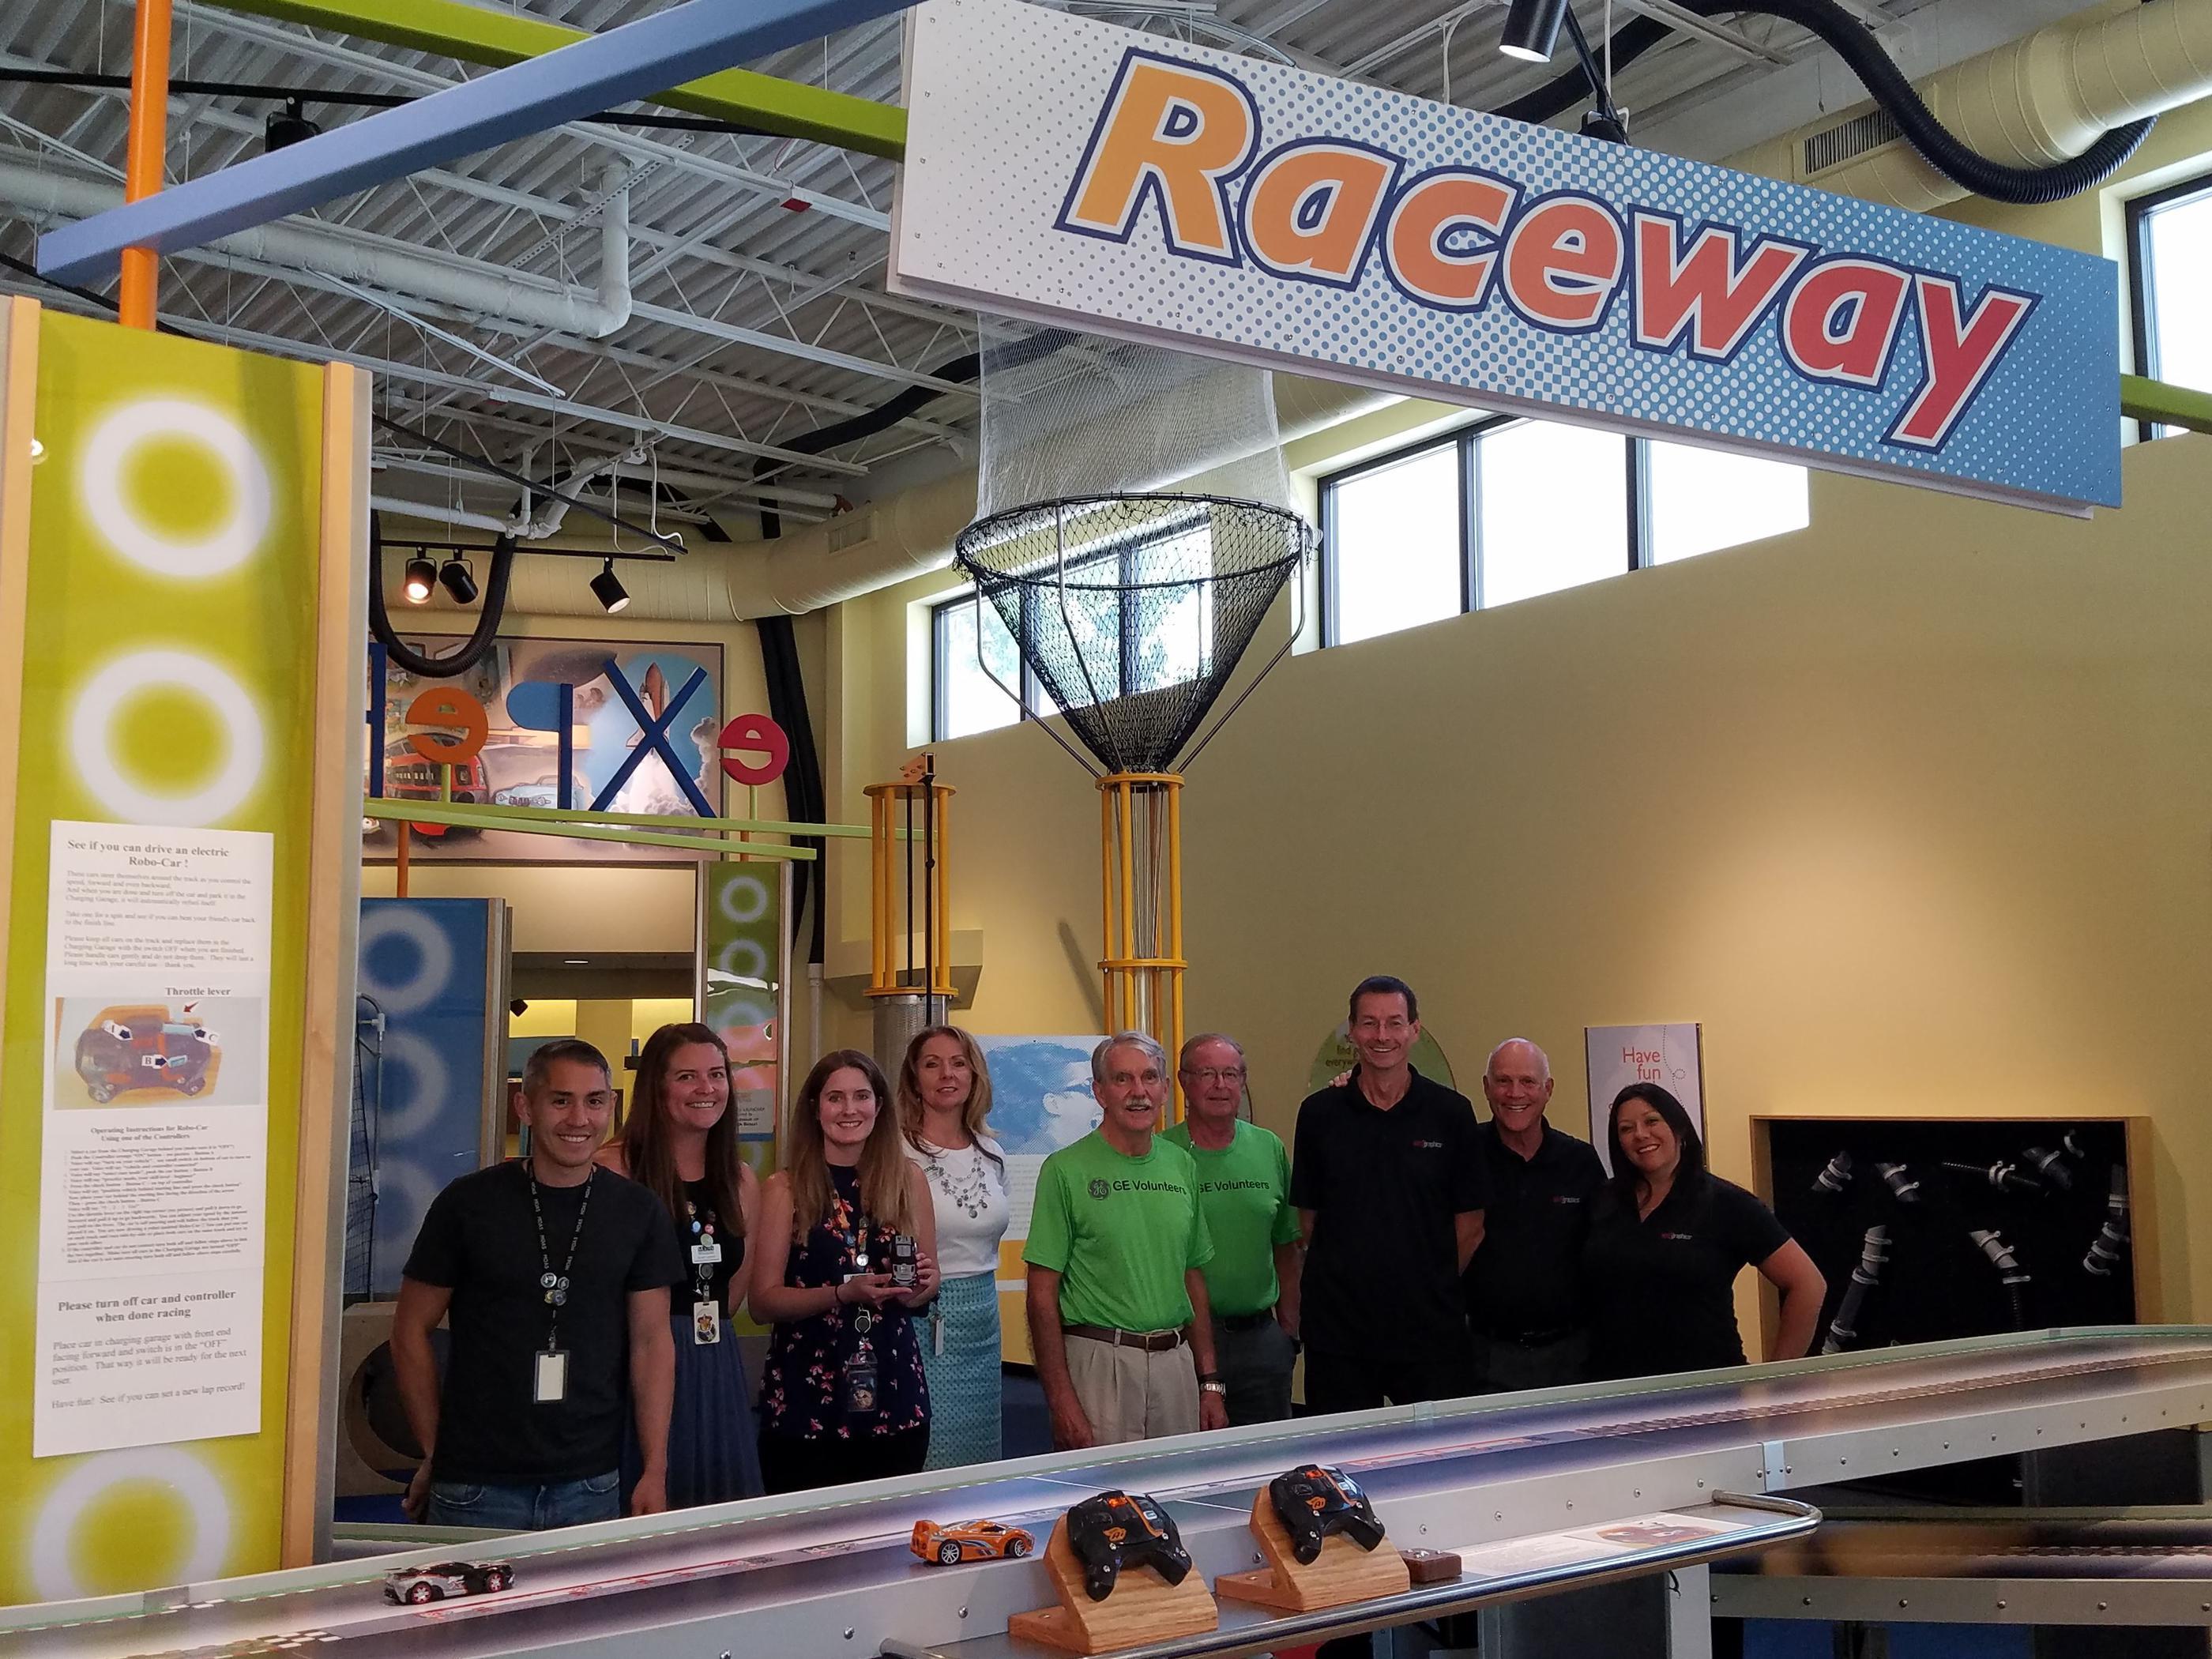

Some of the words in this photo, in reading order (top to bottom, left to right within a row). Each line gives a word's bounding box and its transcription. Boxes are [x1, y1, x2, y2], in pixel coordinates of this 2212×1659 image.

[1055, 46, 2041, 454] Raceway
[67, 840, 85, 850] See
[89, 841, 98, 851] if
[100, 843, 119, 853] you
[123, 845, 141, 853] can
[145, 844, 172, 855] drive
[191, 846, 229, 857] electric
[129, 856, 182, 867] Robo-Car
[165, 987, 205, 996] Throttle
[207, 987, 231, 996] lever
[1622, 1047, 1661, 1063] Have
[1637, 1064, 1661, 1080] fun
[90, 1127, 125, 1135] Operating
[1112, 1179, 1131, 1191] GE
[1214, 1179, 1270, 1192] Volunteers
[58, 1301, 92, 1311] Please
[96, 1300, 119, 1308] turn
[122, 1296, 138, 1307] off
[161, 1293, 181, 1304] and
[184, 1290, 236, 1302] controller
[96, 1312, 124, 1322] when
[128, 1310, 154, 1320] done
[157, 1307, 191, 1319] racing
[53, 1341, 76, 1350] Place
[105, 1337, 141, 1346] charging
[144, 1334, 171, 1344] garage
[174, 1331, 193, 1340] with
[194, 1330, 214, 1338] front
[216, 1327, 231, 1336] end
[82, 1349, 115, 1359] forward
[118, 1346, 134, 1356] and
[136, 1344, 163, 1354] switch
[185, 1341, 198, 1350] the
[96, 1360, 115, 1370] That
[116, 1360, 133, 1369] way
[145, 1356, 161, 1364] will
[175, 1353, 197, 1363] ready
[201, 1351, 213, 1360] for
[214, 1350, 228, 1359] the
[229, 1349, 247, 1357] next
[201, 1385, 215, 1395] lap
